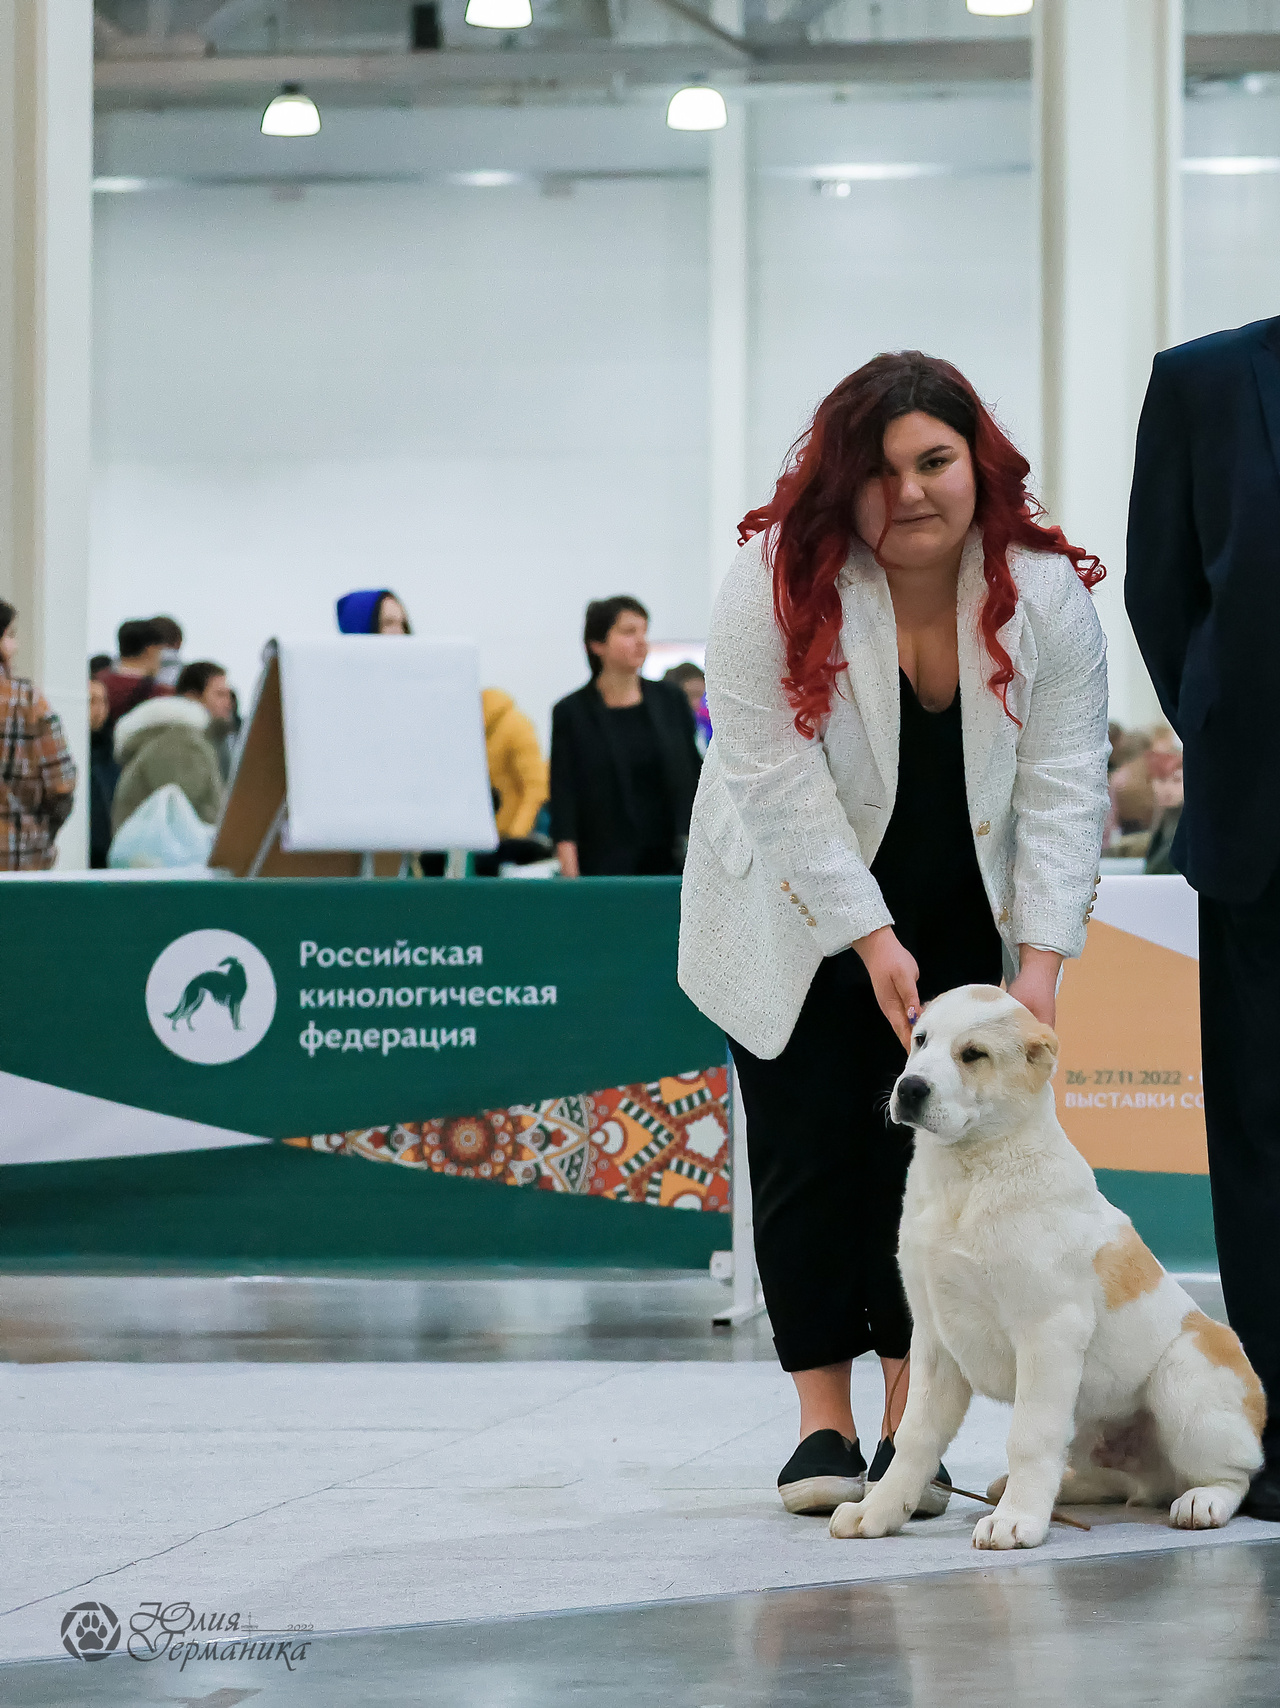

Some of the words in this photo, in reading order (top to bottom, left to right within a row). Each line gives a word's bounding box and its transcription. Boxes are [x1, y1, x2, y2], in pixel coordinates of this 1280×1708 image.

[299, 939, 483, 968] Российская
[299, 985, 558, 1009] кинологическая
[299, 1020, 477, 1057] федерация
[1064, 1092, 1175, 1109] ВЫСТАВКИ
